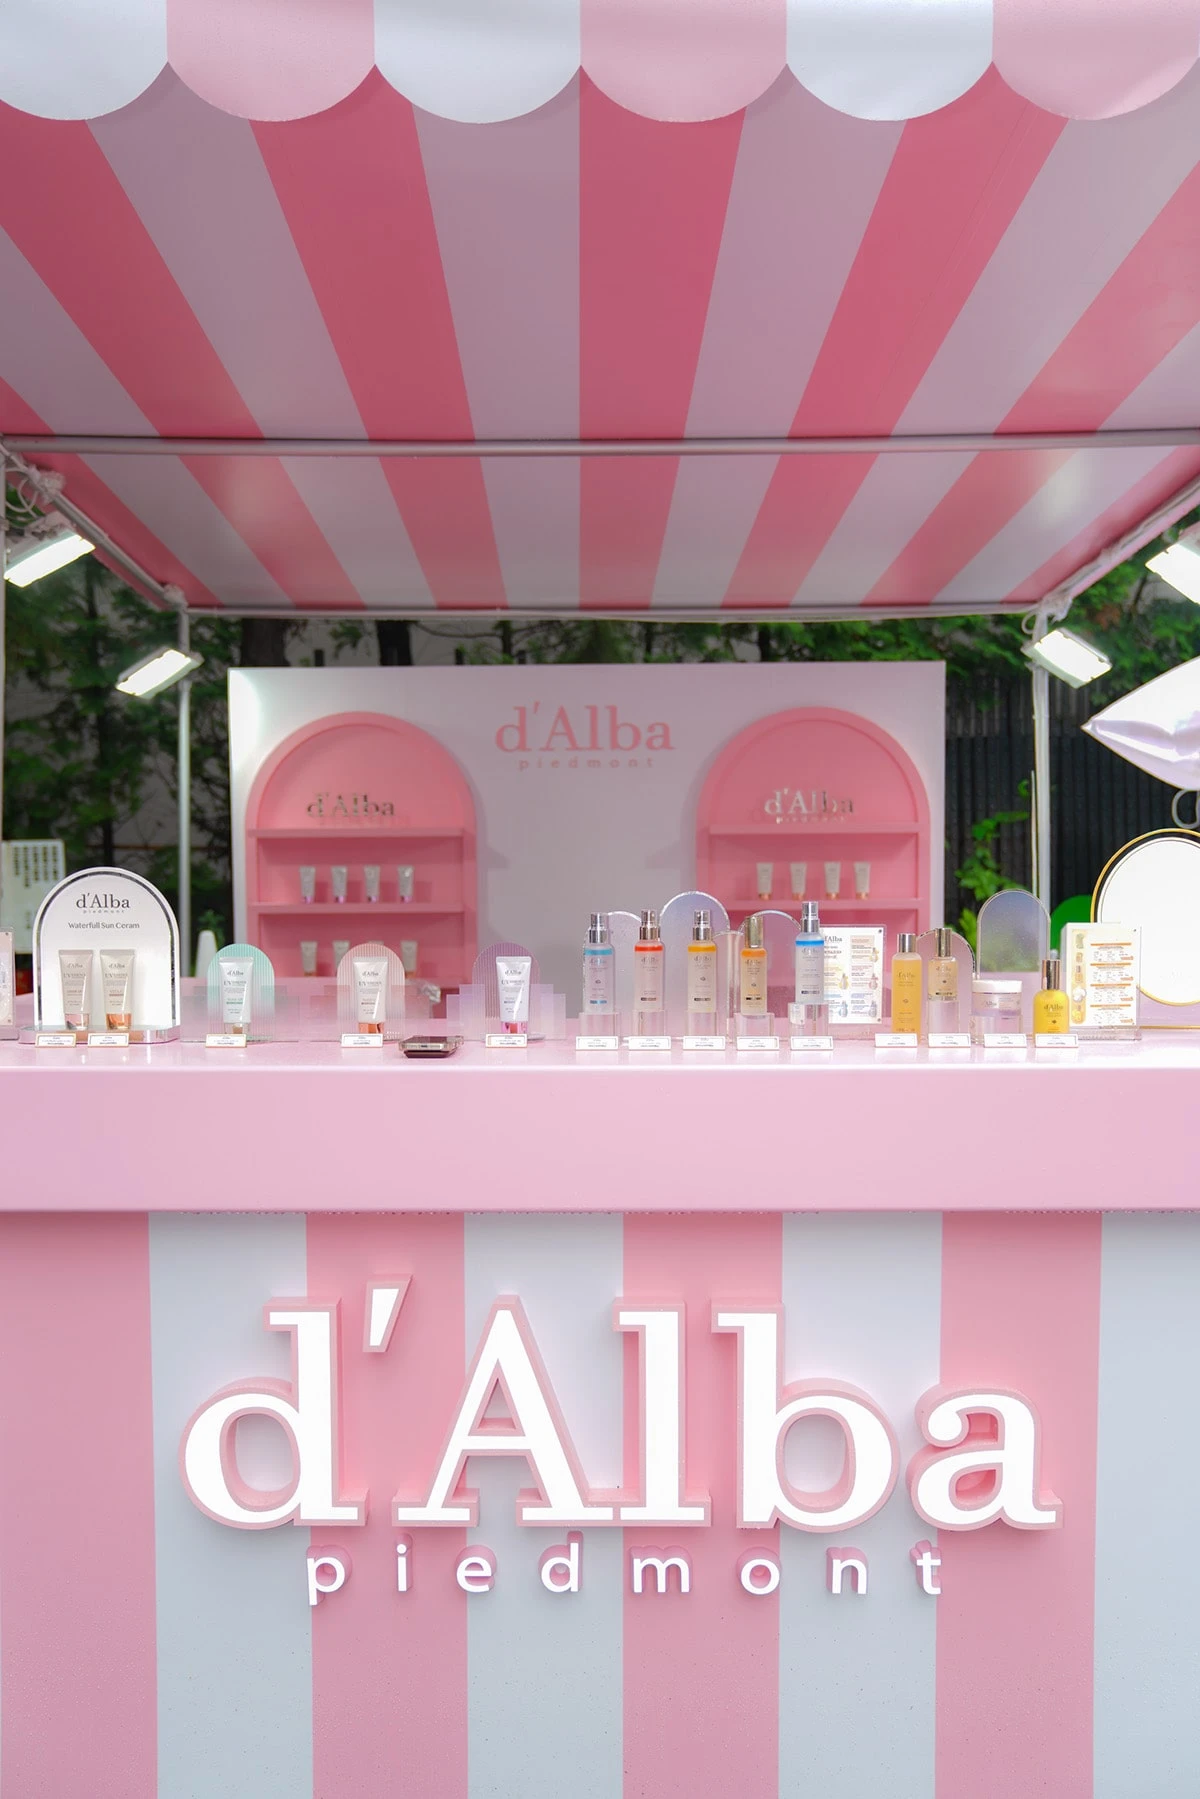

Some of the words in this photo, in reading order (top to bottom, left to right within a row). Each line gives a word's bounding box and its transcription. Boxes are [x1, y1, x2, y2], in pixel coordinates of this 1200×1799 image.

[495, 701, 676, 753] d'Alba
[518, 756, 654, 771] piedmont
[306, 792, 395, 818] d'Alba
[764, 788, 854, 815] d'Alba
[76, 892, 131, 909] d'Alba
[180, 1276, 1063, 1532] d'Alba
[305, 1538, 943, 1606] piedmont
